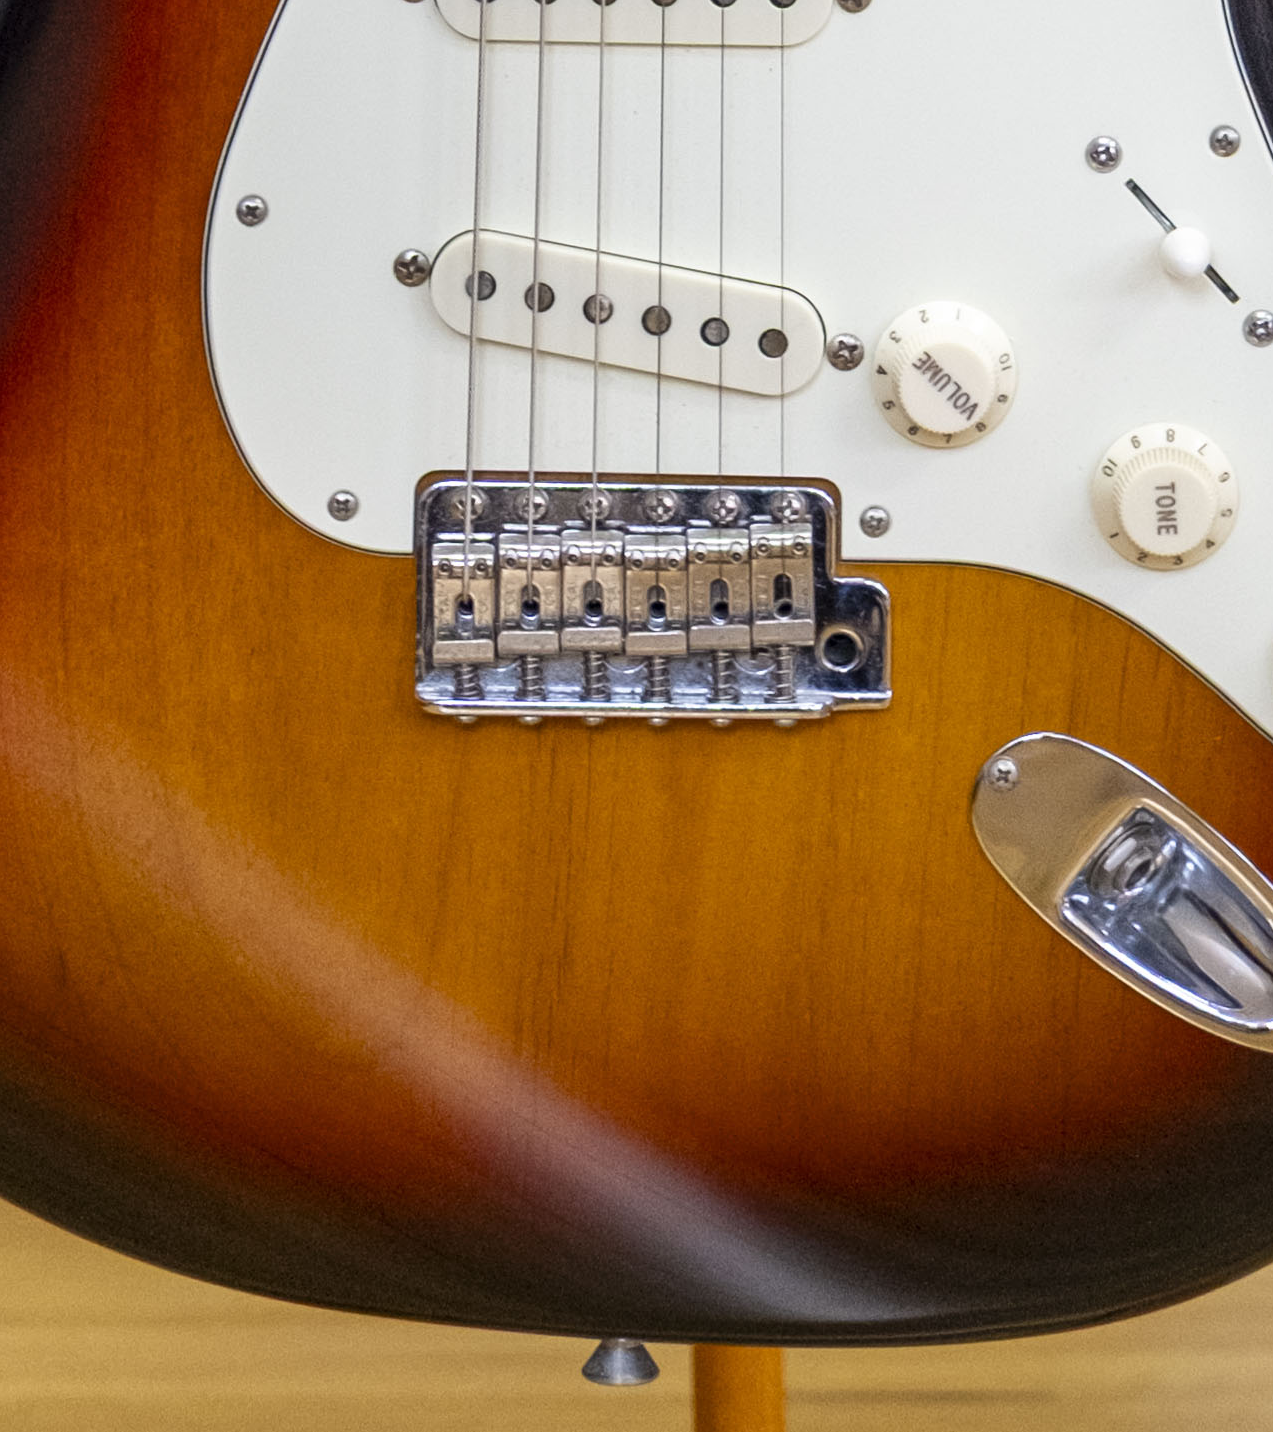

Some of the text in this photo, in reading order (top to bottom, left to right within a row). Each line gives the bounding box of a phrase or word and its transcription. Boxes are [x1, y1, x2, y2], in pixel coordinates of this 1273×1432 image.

[918, 309, 929, 324] 2
[889, 330, 902, 343] 3
[998, 353, 1012, 371] 10
[876, 365, 888, 375] 4
[911, 350, 979, 421] VOLUME
[882, 400, 896, 410] 5
[942, 433, 953, 444] 7
[1130, 435, 1141, 449] 9
[1166, 428, 1175, 443] 8
[1197, 443, 1207, 456] 7
[1102, 458, 1118, 477] 10
[1154, 481, 1178, 536] TONE
[1205, 539, 1216, 549] 4
[1137, 551, 1148, 563] 2
